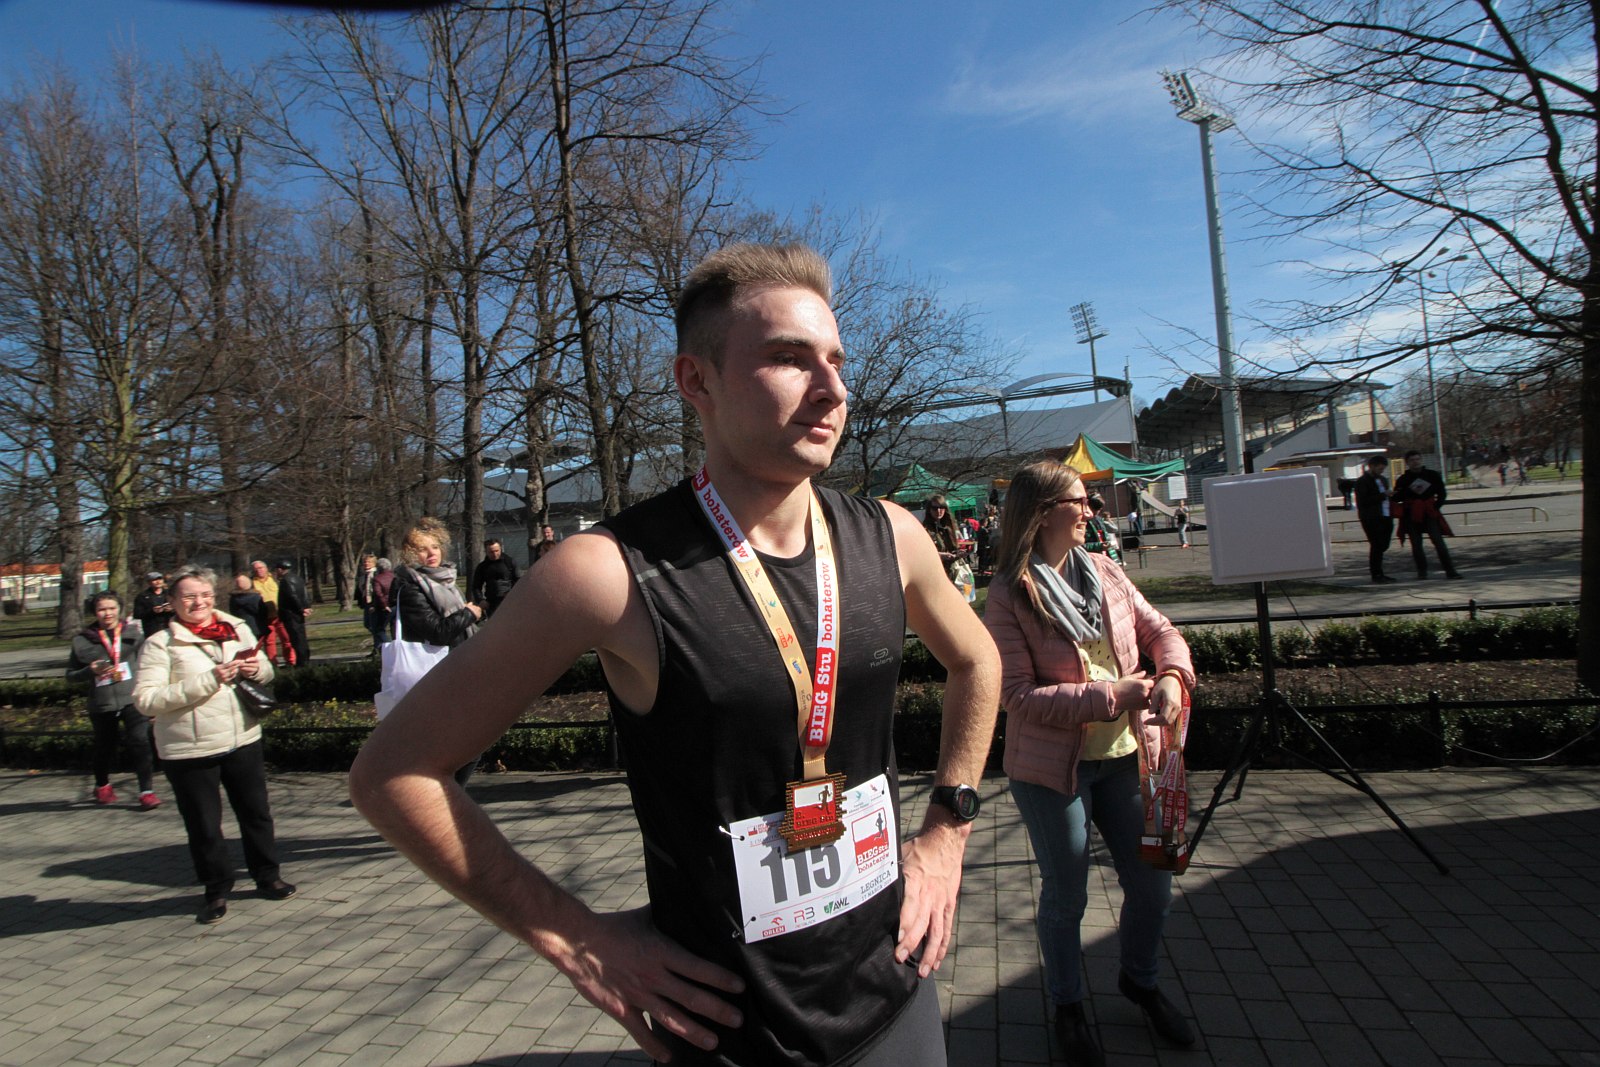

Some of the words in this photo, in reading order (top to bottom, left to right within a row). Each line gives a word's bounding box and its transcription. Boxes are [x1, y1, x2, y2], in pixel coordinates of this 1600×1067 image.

[703, 488, 749, 558] bohaterów
[819, 562, 833, 642] bohaterów
[817, 652, 832, 685] Stu
[809, 690, 829, 742] BIEG
[760, 845, 841, 904] 115
[856, 845, 878, 867] BIEG
[860, 869, 891, 895] LEGNICA
